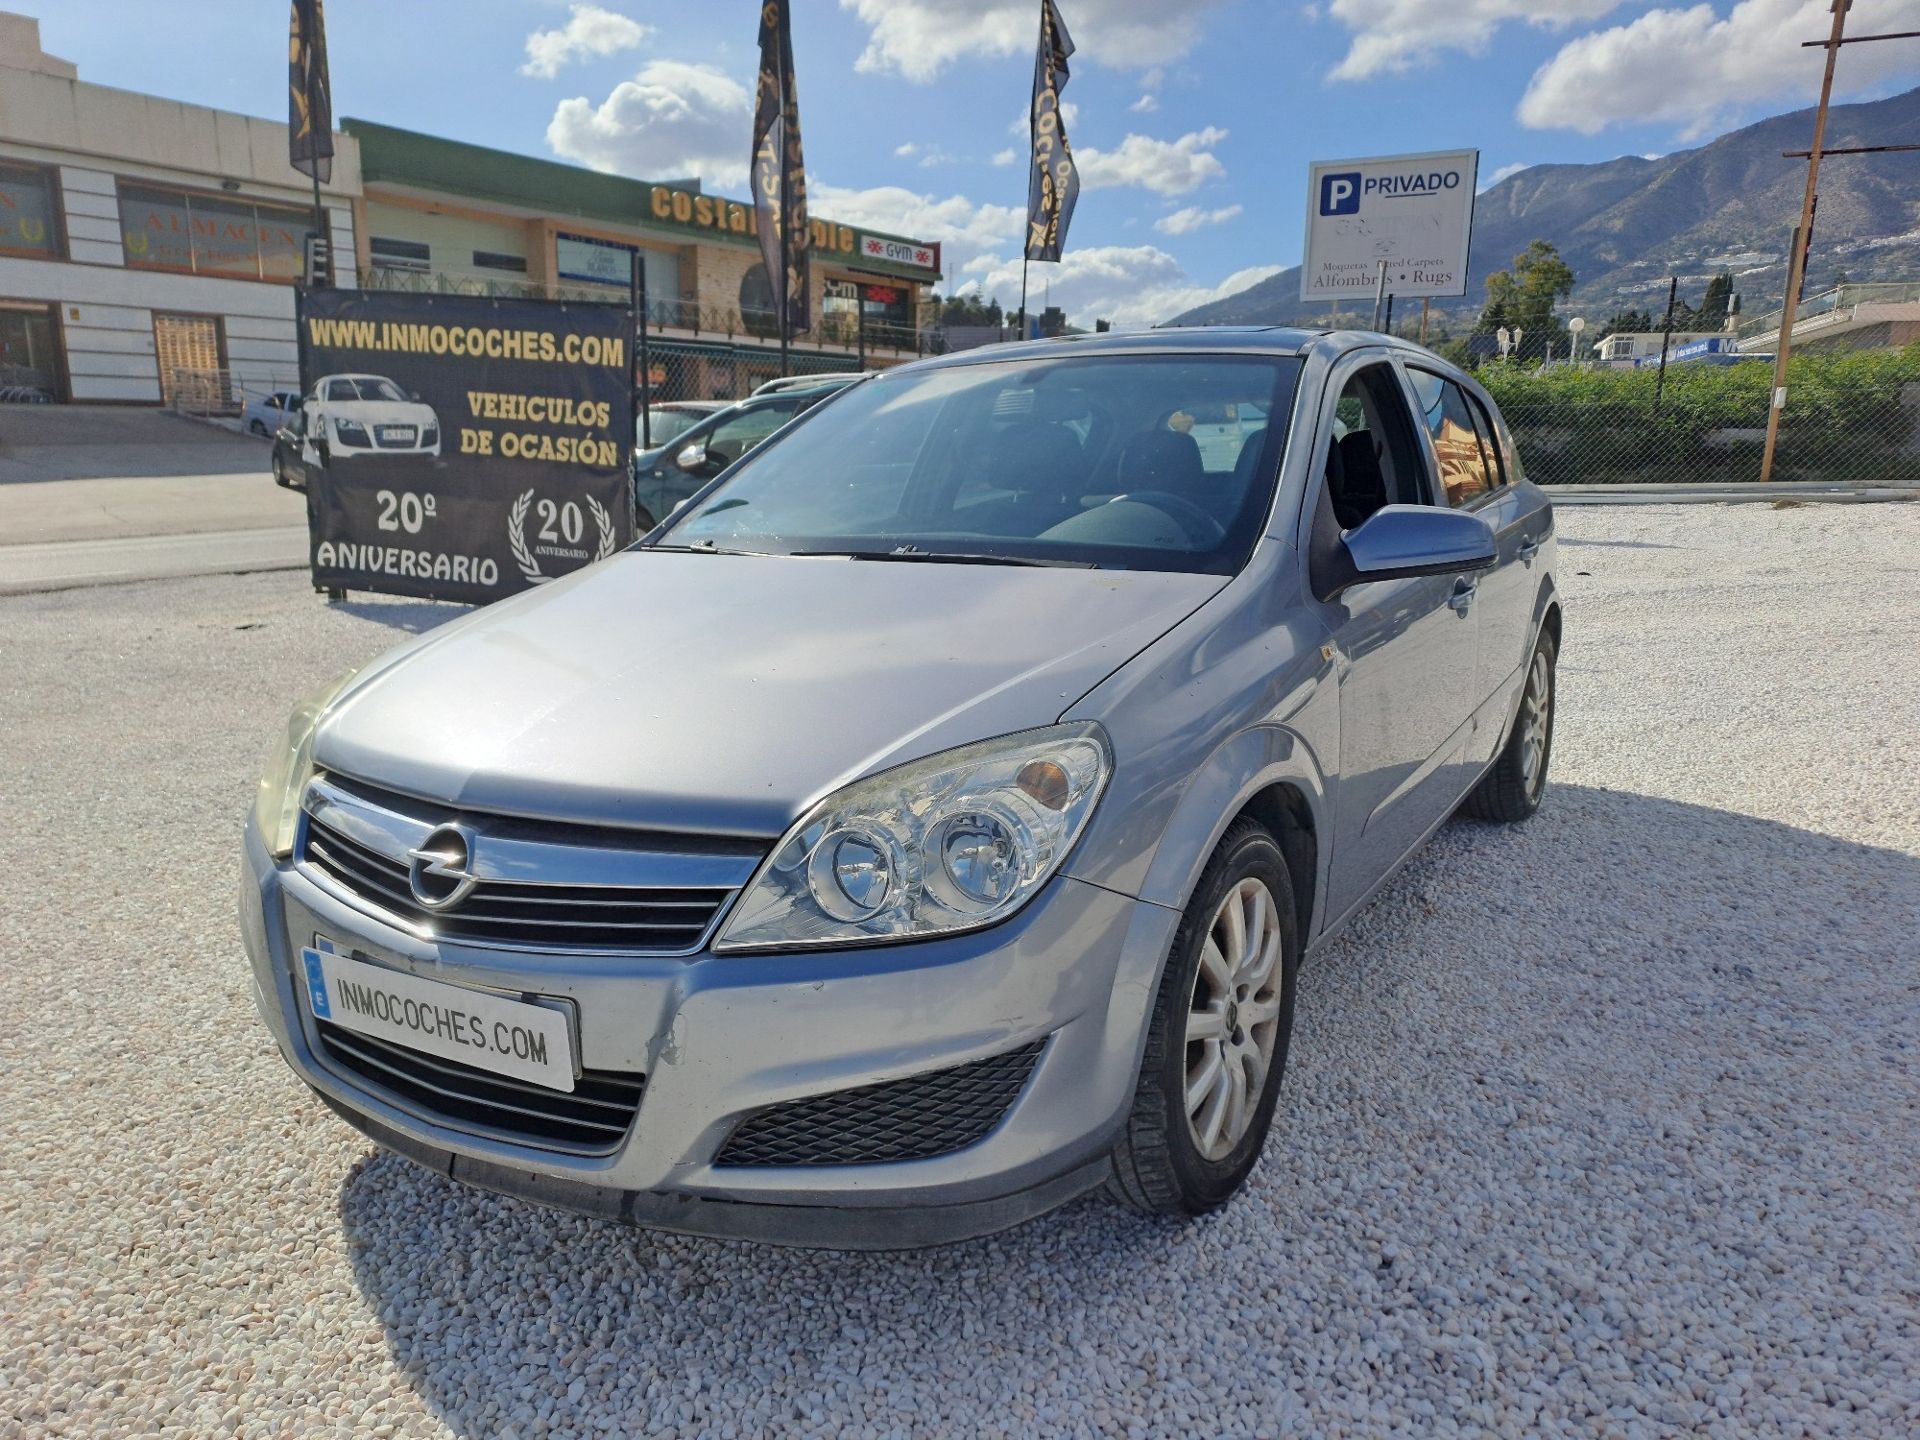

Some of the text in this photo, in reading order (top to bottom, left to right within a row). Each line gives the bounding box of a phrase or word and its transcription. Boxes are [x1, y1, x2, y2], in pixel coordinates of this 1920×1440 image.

[1330, 171, 1460, 210] P PRIVADO
[886, 244, 913, 261] GYM
[1323, 262, 1368, 272] Moquetas
[1407, 258, 1444, 269] Carpets
[1314, 270, 1453, 288] Alfombrs Rugs
[310, 318, 624, 368] WWW.INMOCOCHES.COM
[467, 391, 611, 428] VEHICULOS
[461, 429, 618, 467] DE OCASIÓN
[537, 498, 584, 544] 20
[317, 541, 499, 586] ANIVERSARIO
[535, 545, 589, 560] ANIVERSARIO
[316, 991, 324, 1007] E
[337, 978, 548, 1066] INMOCOCHES.COM
